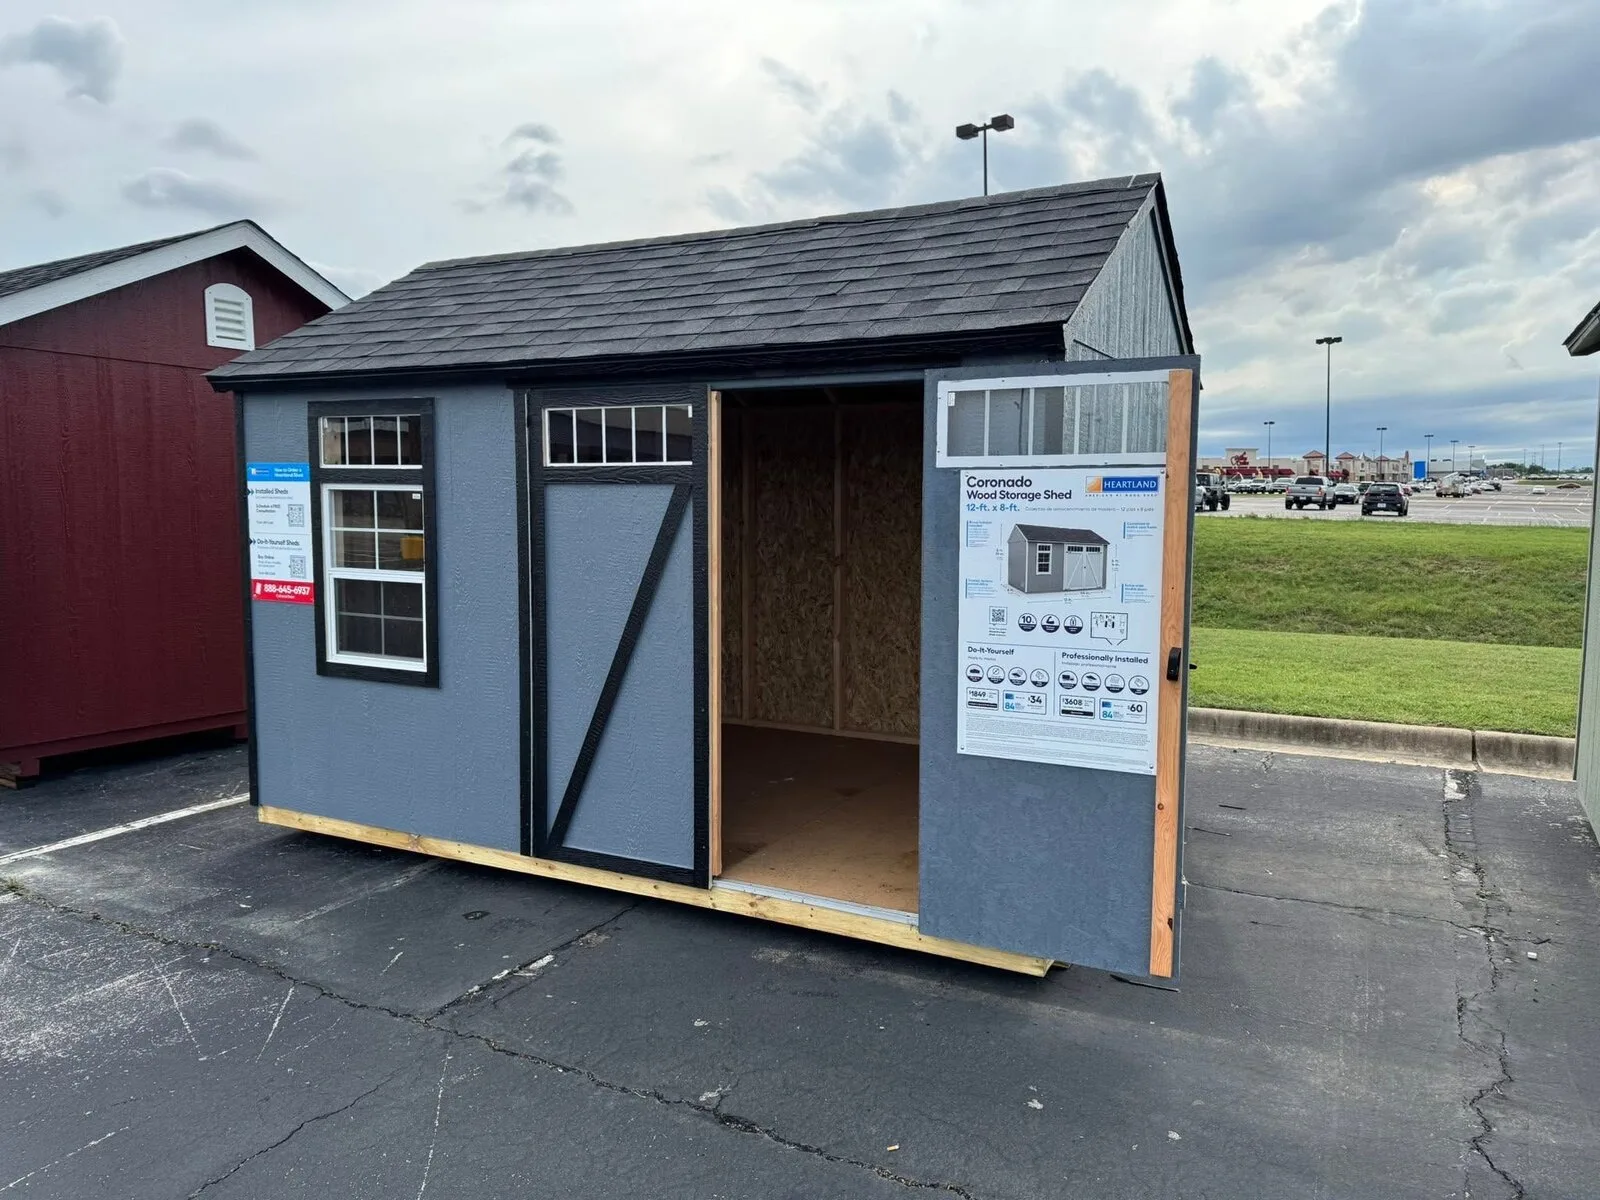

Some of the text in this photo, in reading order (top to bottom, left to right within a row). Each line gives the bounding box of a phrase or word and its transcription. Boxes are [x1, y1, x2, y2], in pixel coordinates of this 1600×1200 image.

[966, 475, 1032, 488] Coronado
[1103, 480, 1157, 488] HEARTLAND
[966, 490, 1072, 502] Wood Storage Shed
[966, 503, 990, 511] 12-ft.
[1000, 503, 1020, 511] 8-ft.
[1022, 615, 1032, 624] 10
[967, 646, 1015, 656] Do-It-Yourself
[1061, 652, 1149, 664] Professionally Installed
[1005, 702, 1015, 710] 84
